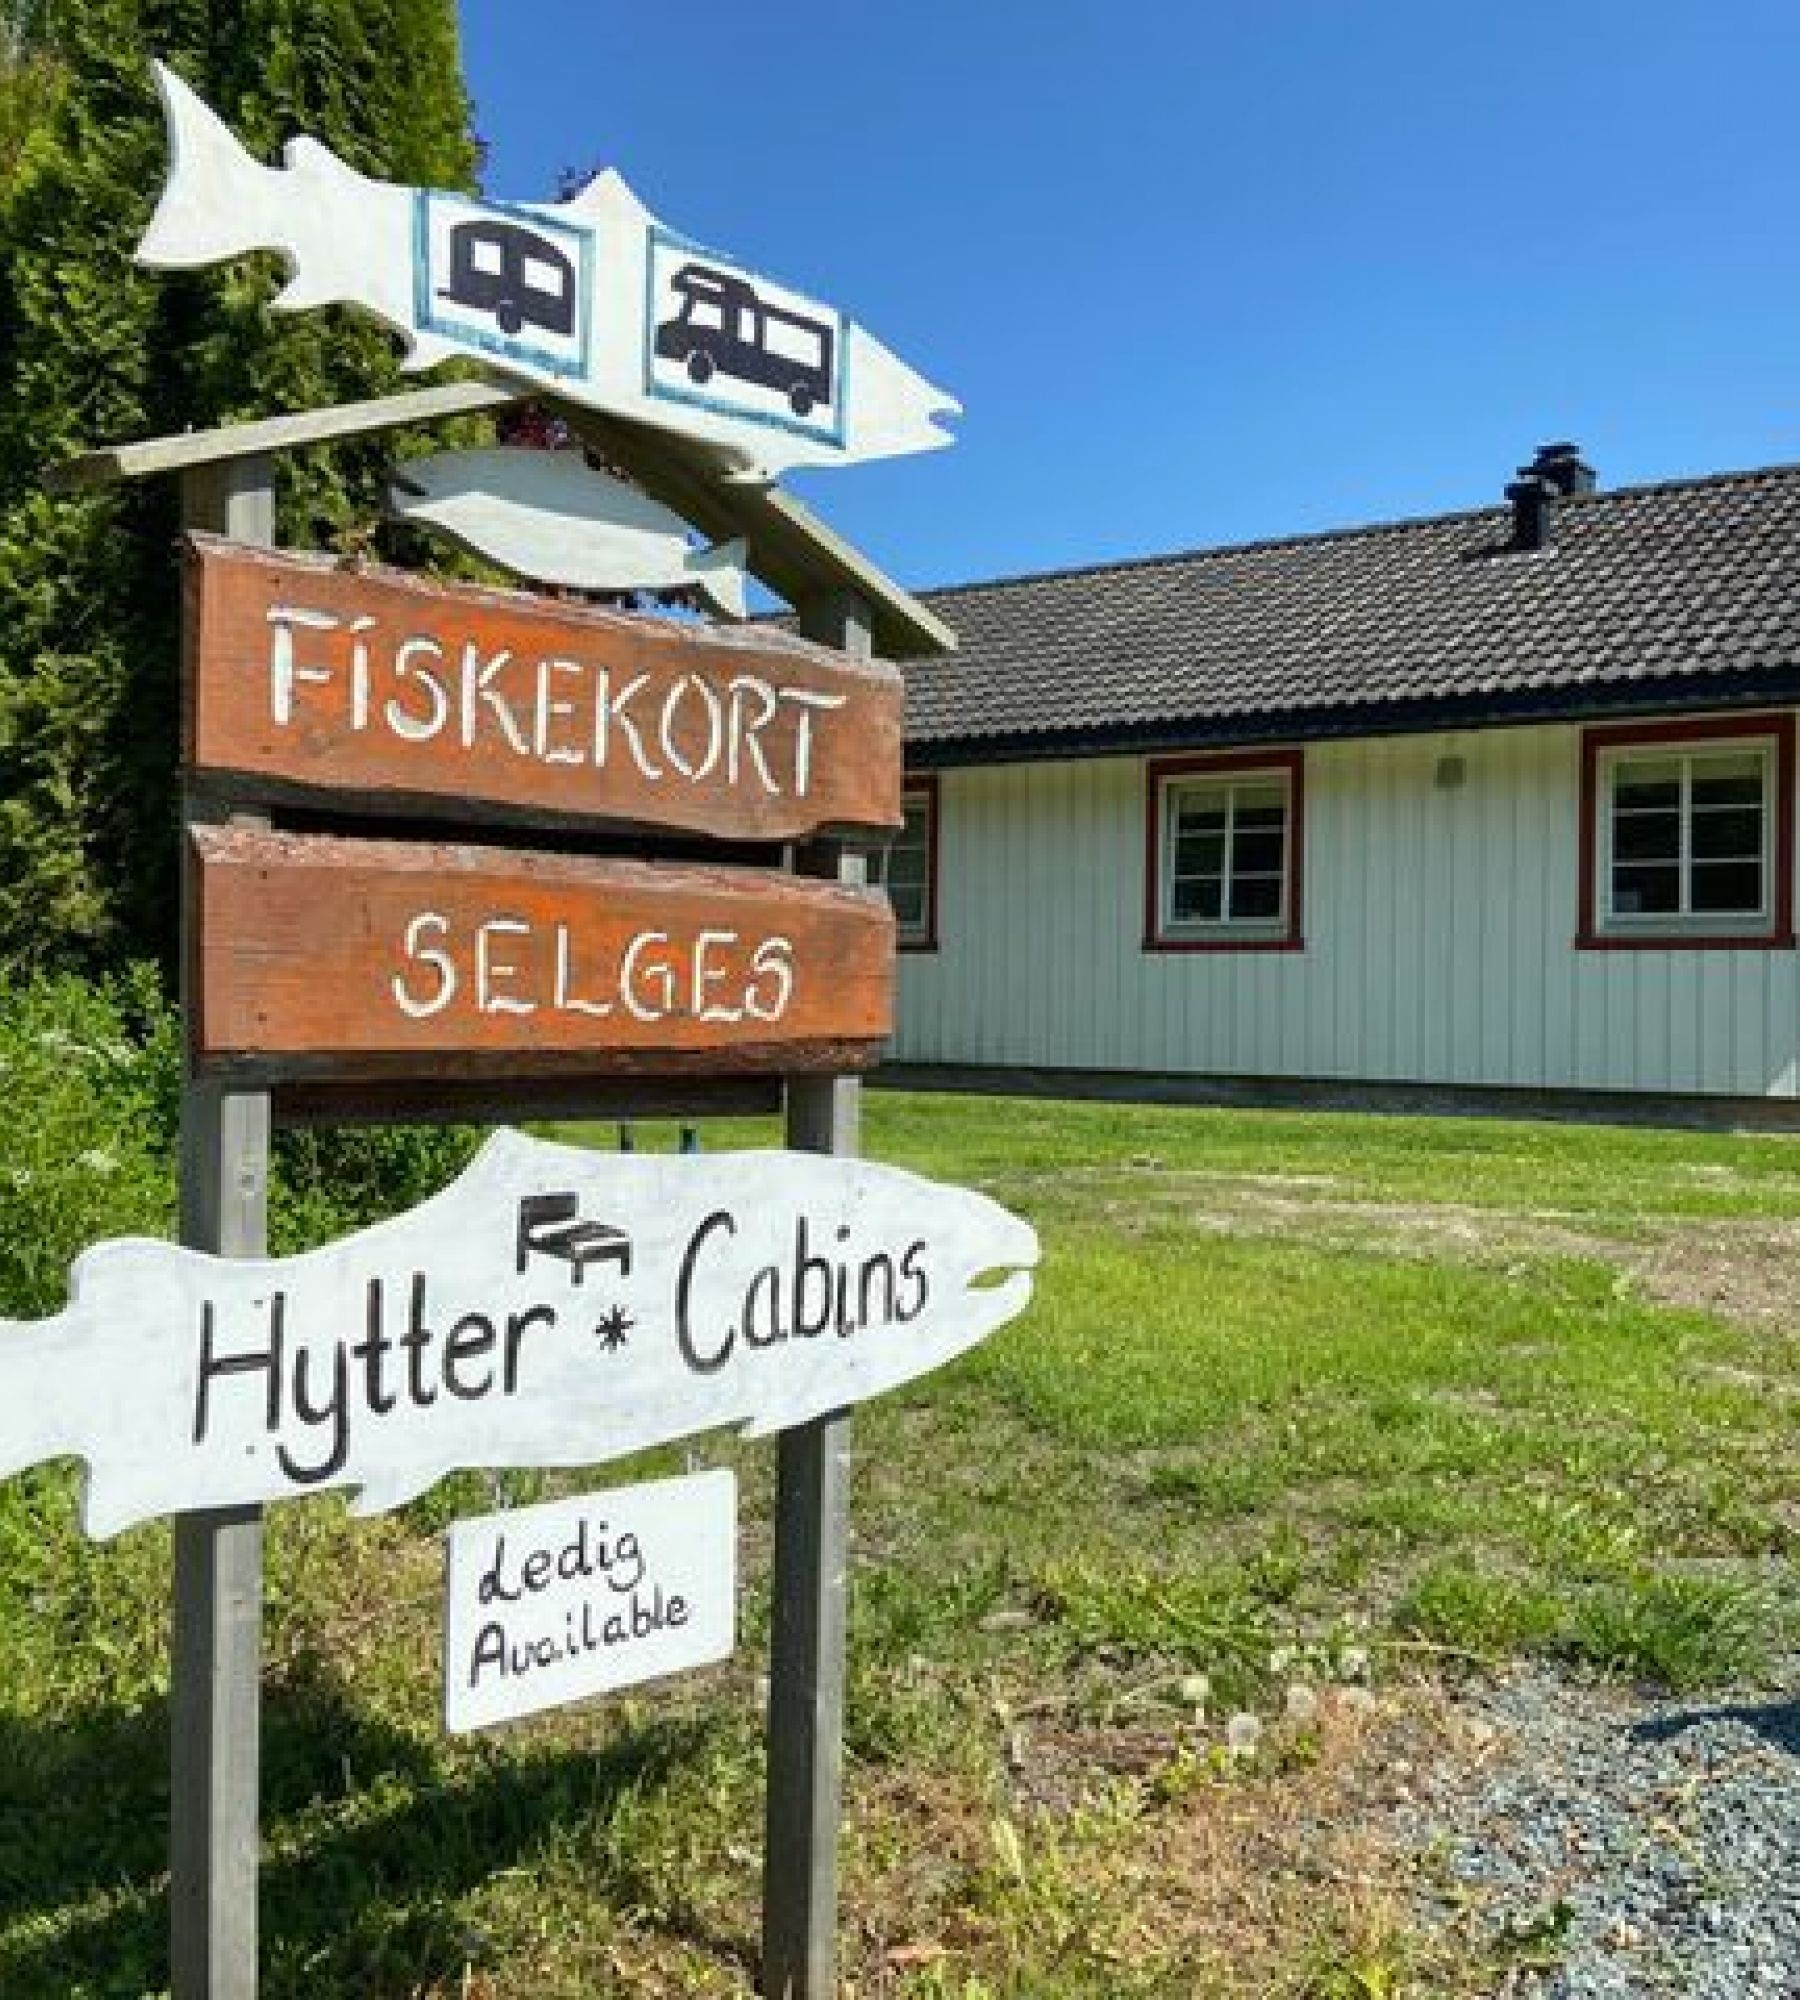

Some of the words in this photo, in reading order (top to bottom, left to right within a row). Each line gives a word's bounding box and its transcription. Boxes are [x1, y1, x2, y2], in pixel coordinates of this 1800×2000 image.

[391, 913, 794, 1022] SELGES
[193, 1272, 559, 1485] Hytter
[675, 1210, 930, 1375] Cabins
[478, 1518, 645, 1606] Ledig
[468, 1585, 690, 1688] Available
